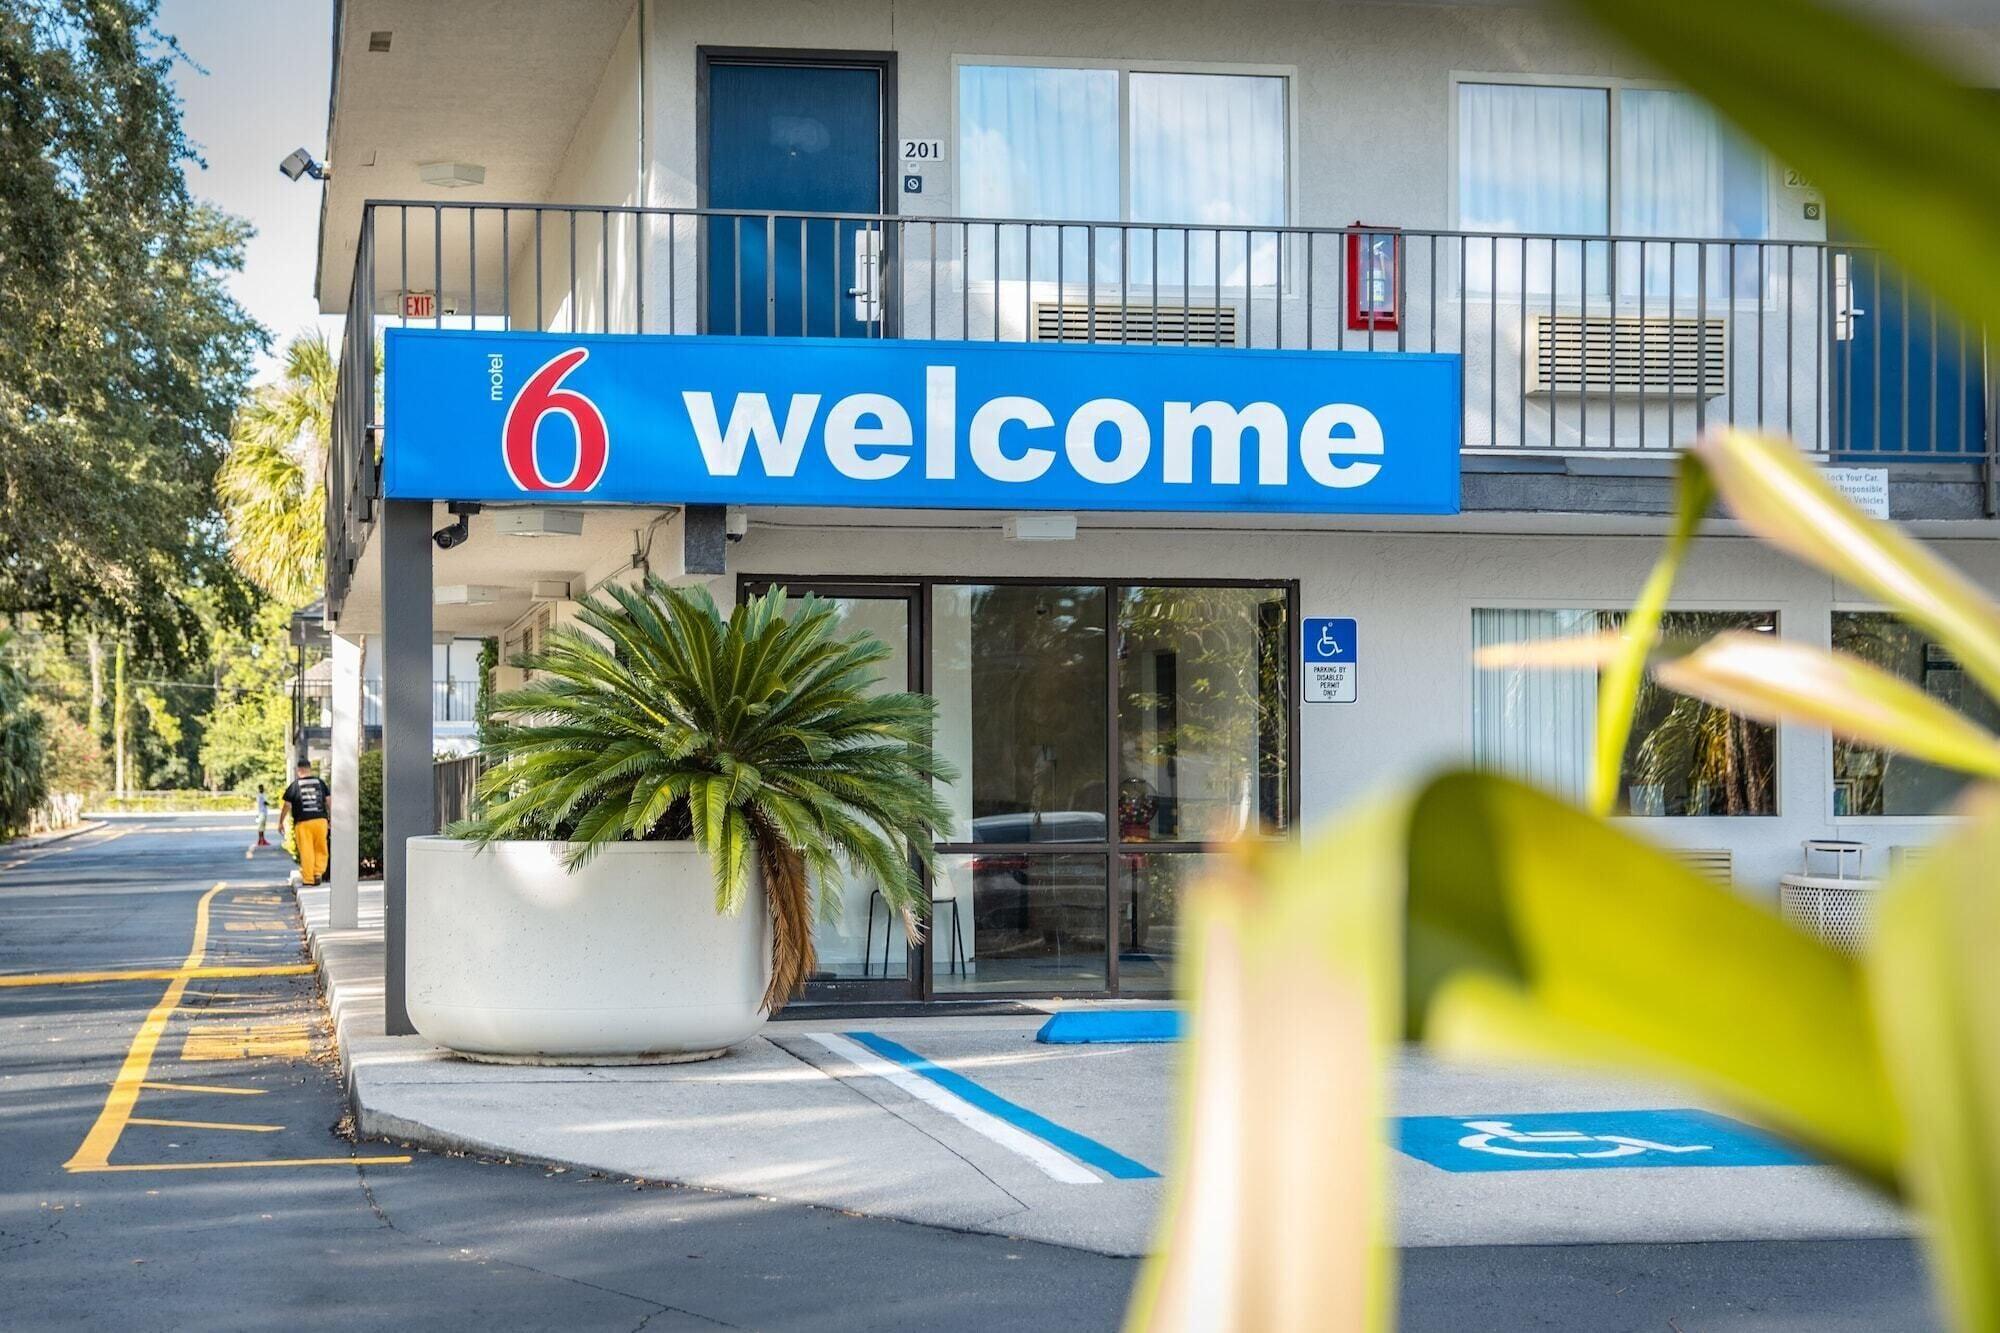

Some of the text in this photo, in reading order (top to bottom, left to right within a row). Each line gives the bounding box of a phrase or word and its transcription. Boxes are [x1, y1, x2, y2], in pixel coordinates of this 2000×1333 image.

[905, 142, 938, 158] 201
[406, 296, 431, 316] EXIT
[488, 353, 503, 401] motel
[502, 346, 610, 492] 6
[682, 365, 1385, 488] welcome
[1846, 473, 1863, 482] Your
[1840, 485, 1883, 494] Responsible
[1854, 496, 1884, 505] Vehicles
[1320, 681, 1340, 689] PERMIT
